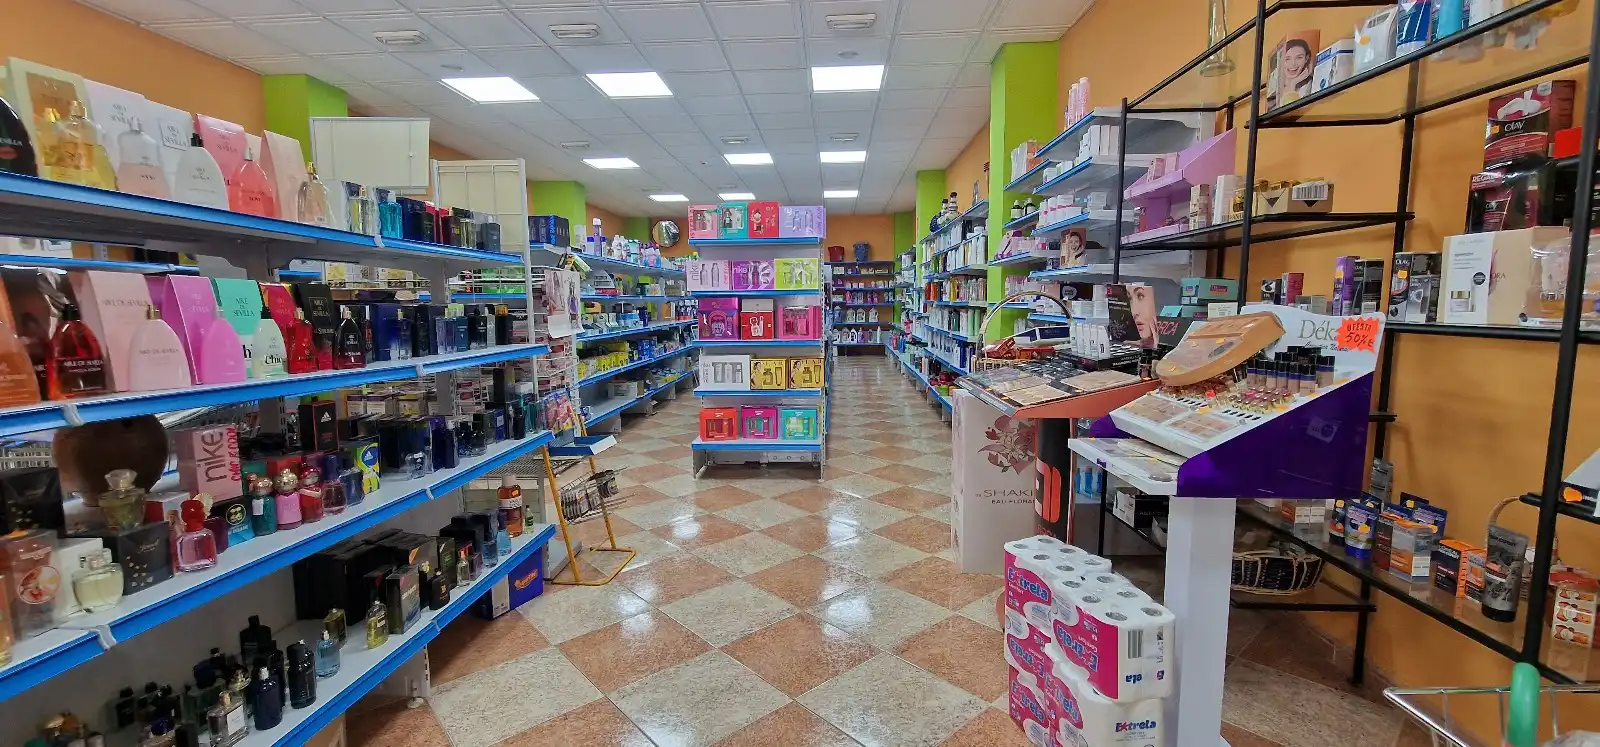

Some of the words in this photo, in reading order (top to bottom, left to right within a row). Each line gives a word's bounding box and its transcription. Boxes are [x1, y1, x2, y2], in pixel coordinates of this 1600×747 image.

[1504, 120, 1525, 132] OLAY
[196, 430, 227, 482] nike
[984, 490, 1033, 498] SHAKI
[1115, 720, 1156, 732] Extrela
